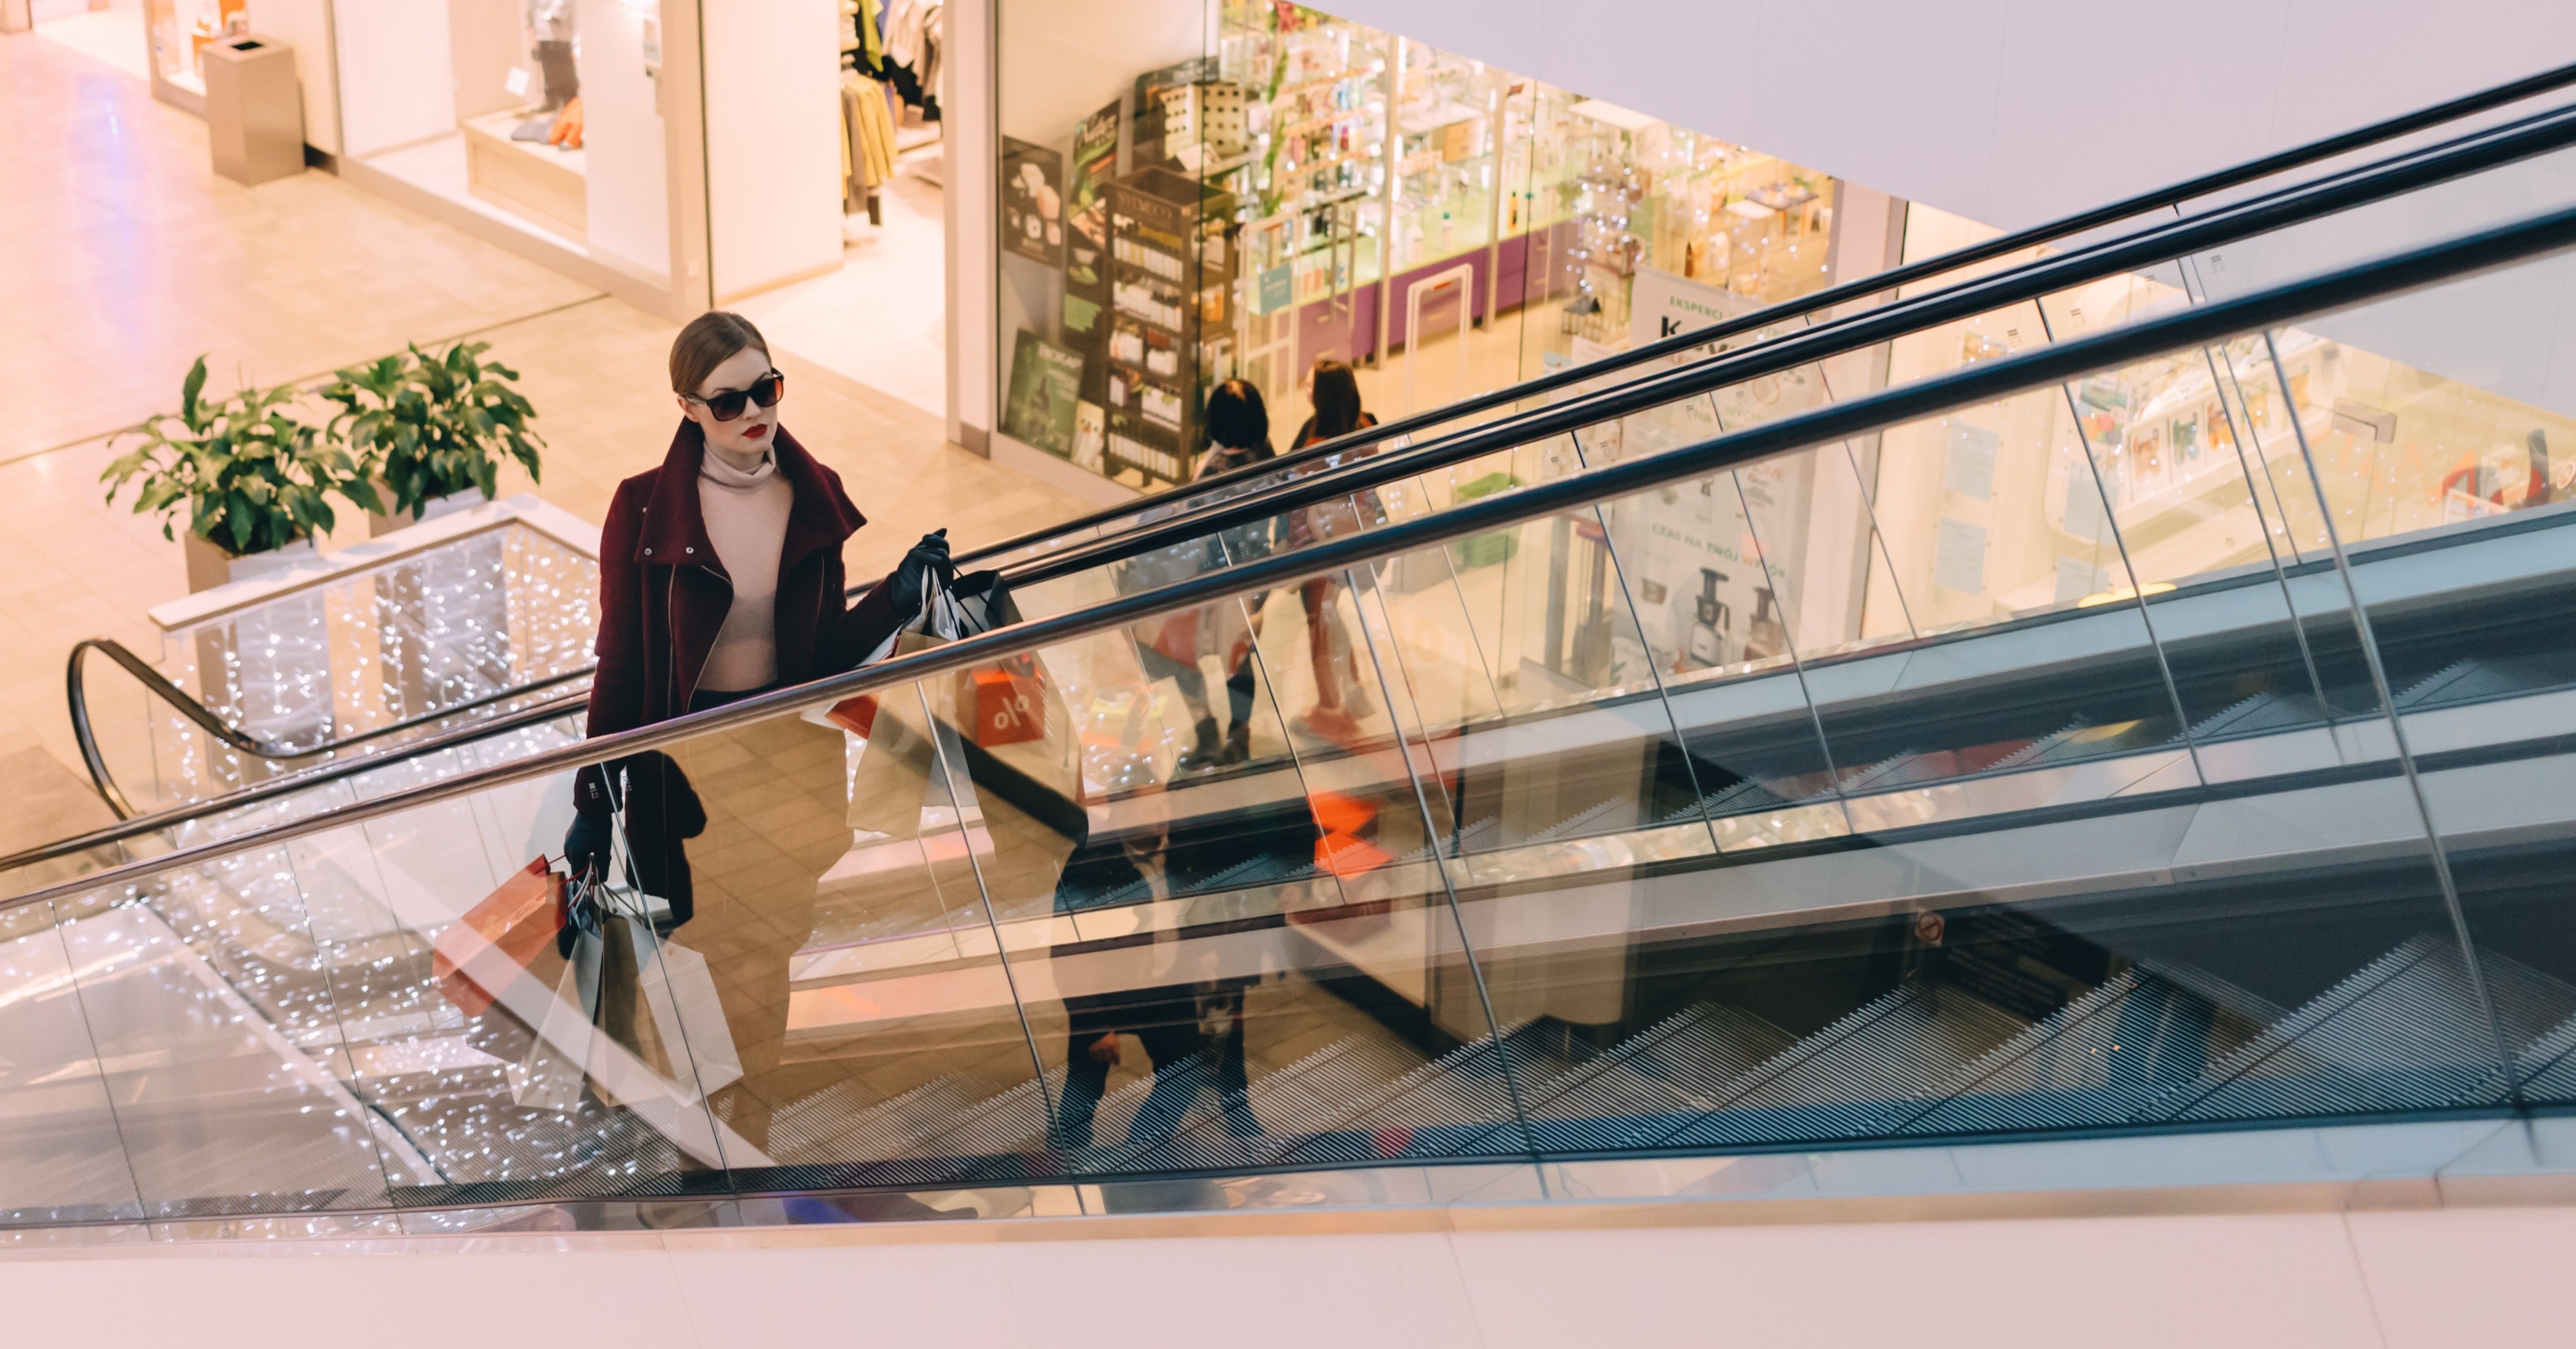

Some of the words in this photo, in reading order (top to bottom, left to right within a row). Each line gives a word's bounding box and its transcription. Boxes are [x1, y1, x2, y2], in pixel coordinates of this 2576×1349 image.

[1670, 296, 1722, 320] EKSPERCI
[1652, 523, 1681, 541] CZAS
[1685, 535, 1702, 548] NA
[1707, 542, 1738, 562] TWÓJ
